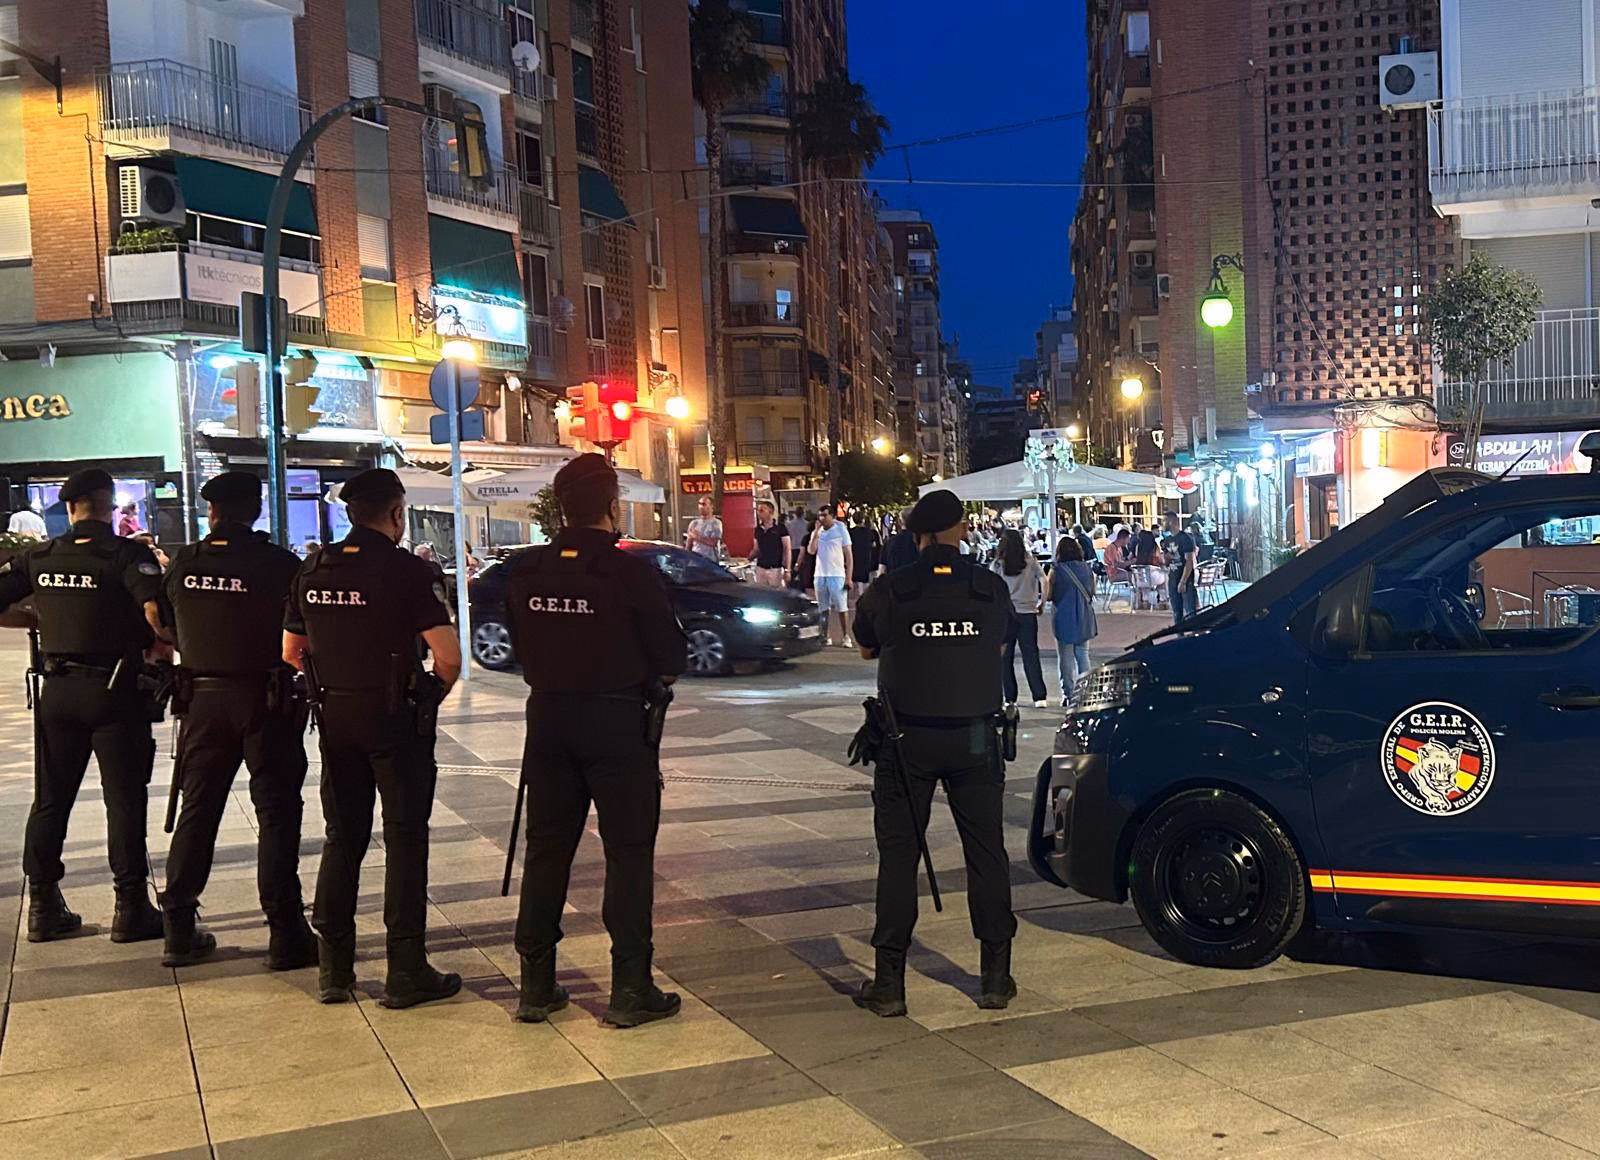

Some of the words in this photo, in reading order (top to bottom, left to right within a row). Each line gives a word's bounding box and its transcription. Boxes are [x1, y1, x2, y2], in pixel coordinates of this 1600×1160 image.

[0, 394, 71, 419] nca
[37, 573, 98, 589] G.E.I.R.
[183, 575, 248, 592] G.E.I.R.
[305, 590, 367, 606] G.E.I.R.
[528, 596, 595, 614] G.E.I.R.
[911, 621, 980, 637] G.E.I.R.
[1393, 721, 1406, 735] DE
[1410, 714, 1467, 727] G.E.I.R.
[1386, 736, 1399, 780] ESPECIAL
[1396, 782, 1424, 808] GRUPO
